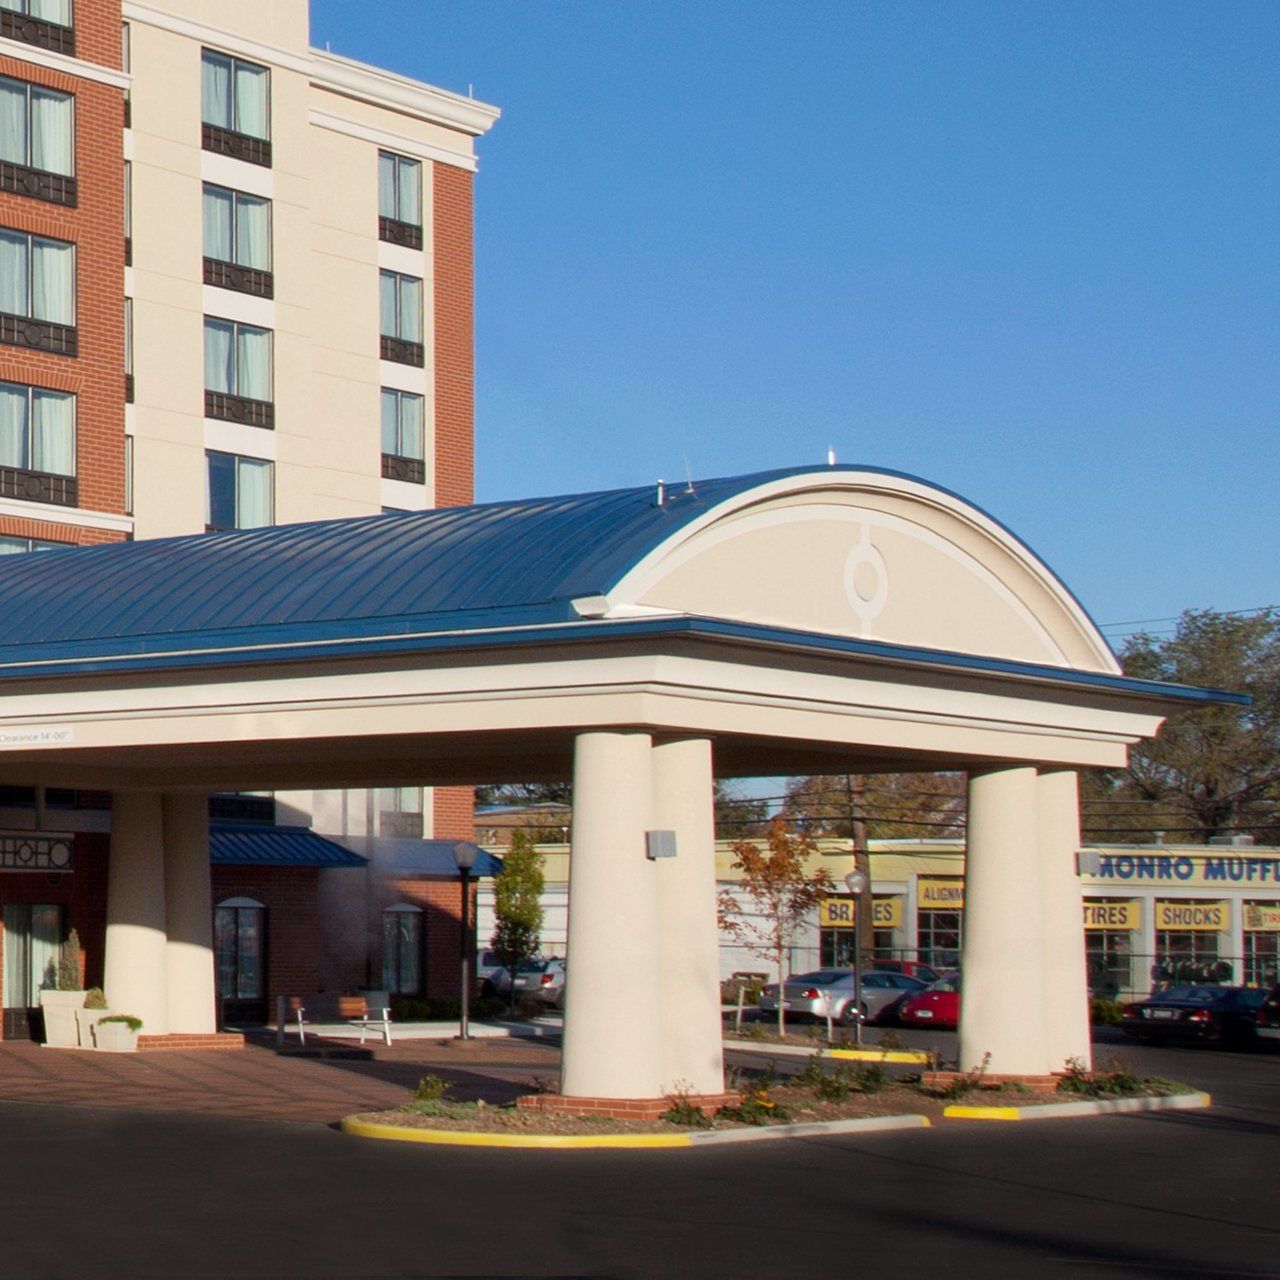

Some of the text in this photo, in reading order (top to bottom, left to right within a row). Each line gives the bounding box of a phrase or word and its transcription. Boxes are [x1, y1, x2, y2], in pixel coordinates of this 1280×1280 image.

[828, 903, 893, 921] BRES
[1082, 906, 1128, 925] TIRES
[1162, 907, 1222, 926] SHOCKS
